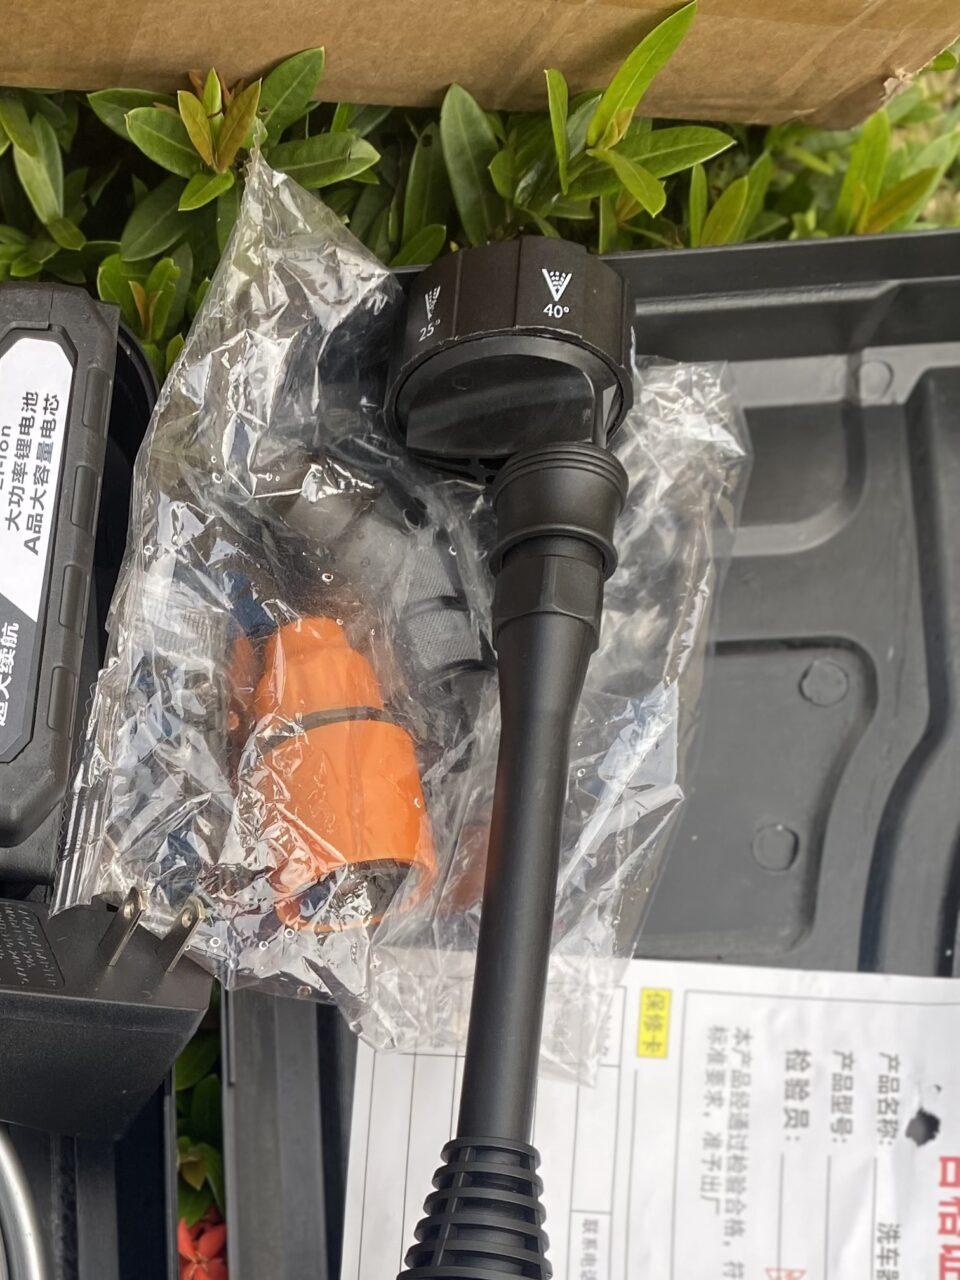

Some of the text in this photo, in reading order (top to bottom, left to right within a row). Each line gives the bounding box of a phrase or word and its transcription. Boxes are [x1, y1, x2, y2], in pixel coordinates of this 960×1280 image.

[5, 391, 40, 532] 大功率锂电池
[23, 393, 60, 556] A品大容量电芯
